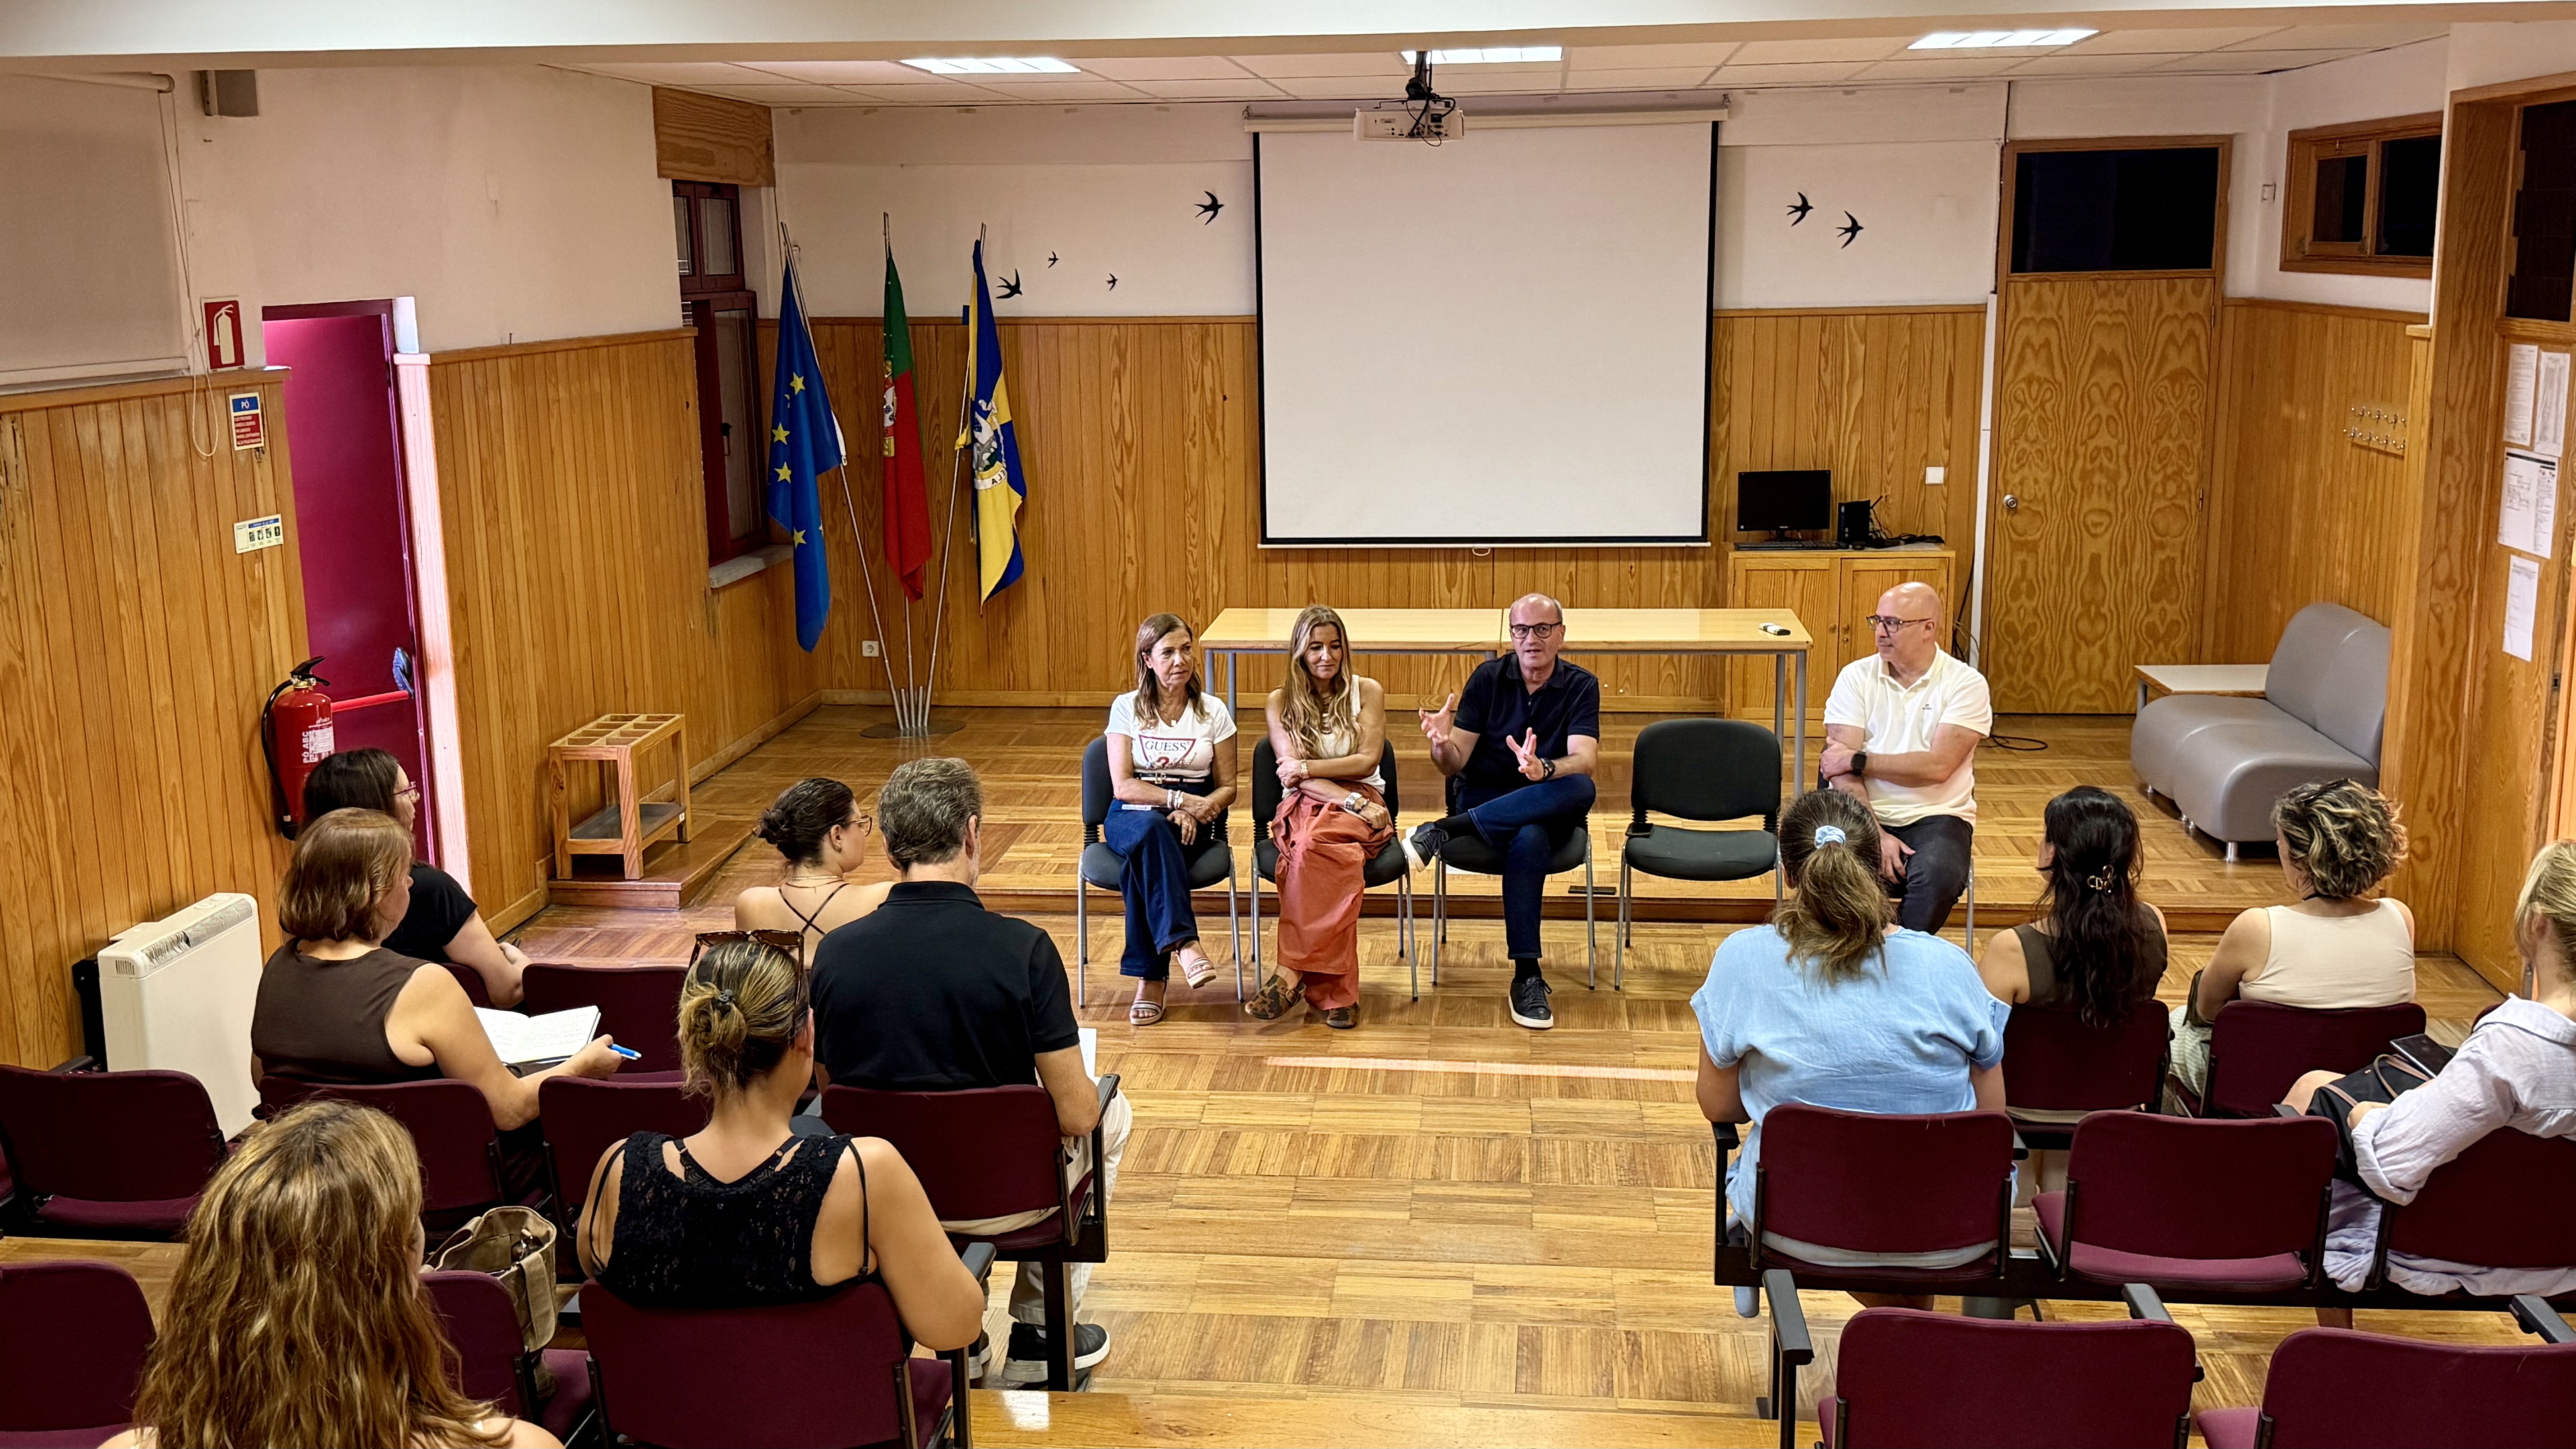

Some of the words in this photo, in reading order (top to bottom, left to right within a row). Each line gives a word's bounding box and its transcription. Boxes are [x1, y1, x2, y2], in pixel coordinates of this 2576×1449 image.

[241, 399, 250, 409] PÓ
[1145, 741, 1187, 751] GUESS
[301, 751, 309, 763] PÓ
